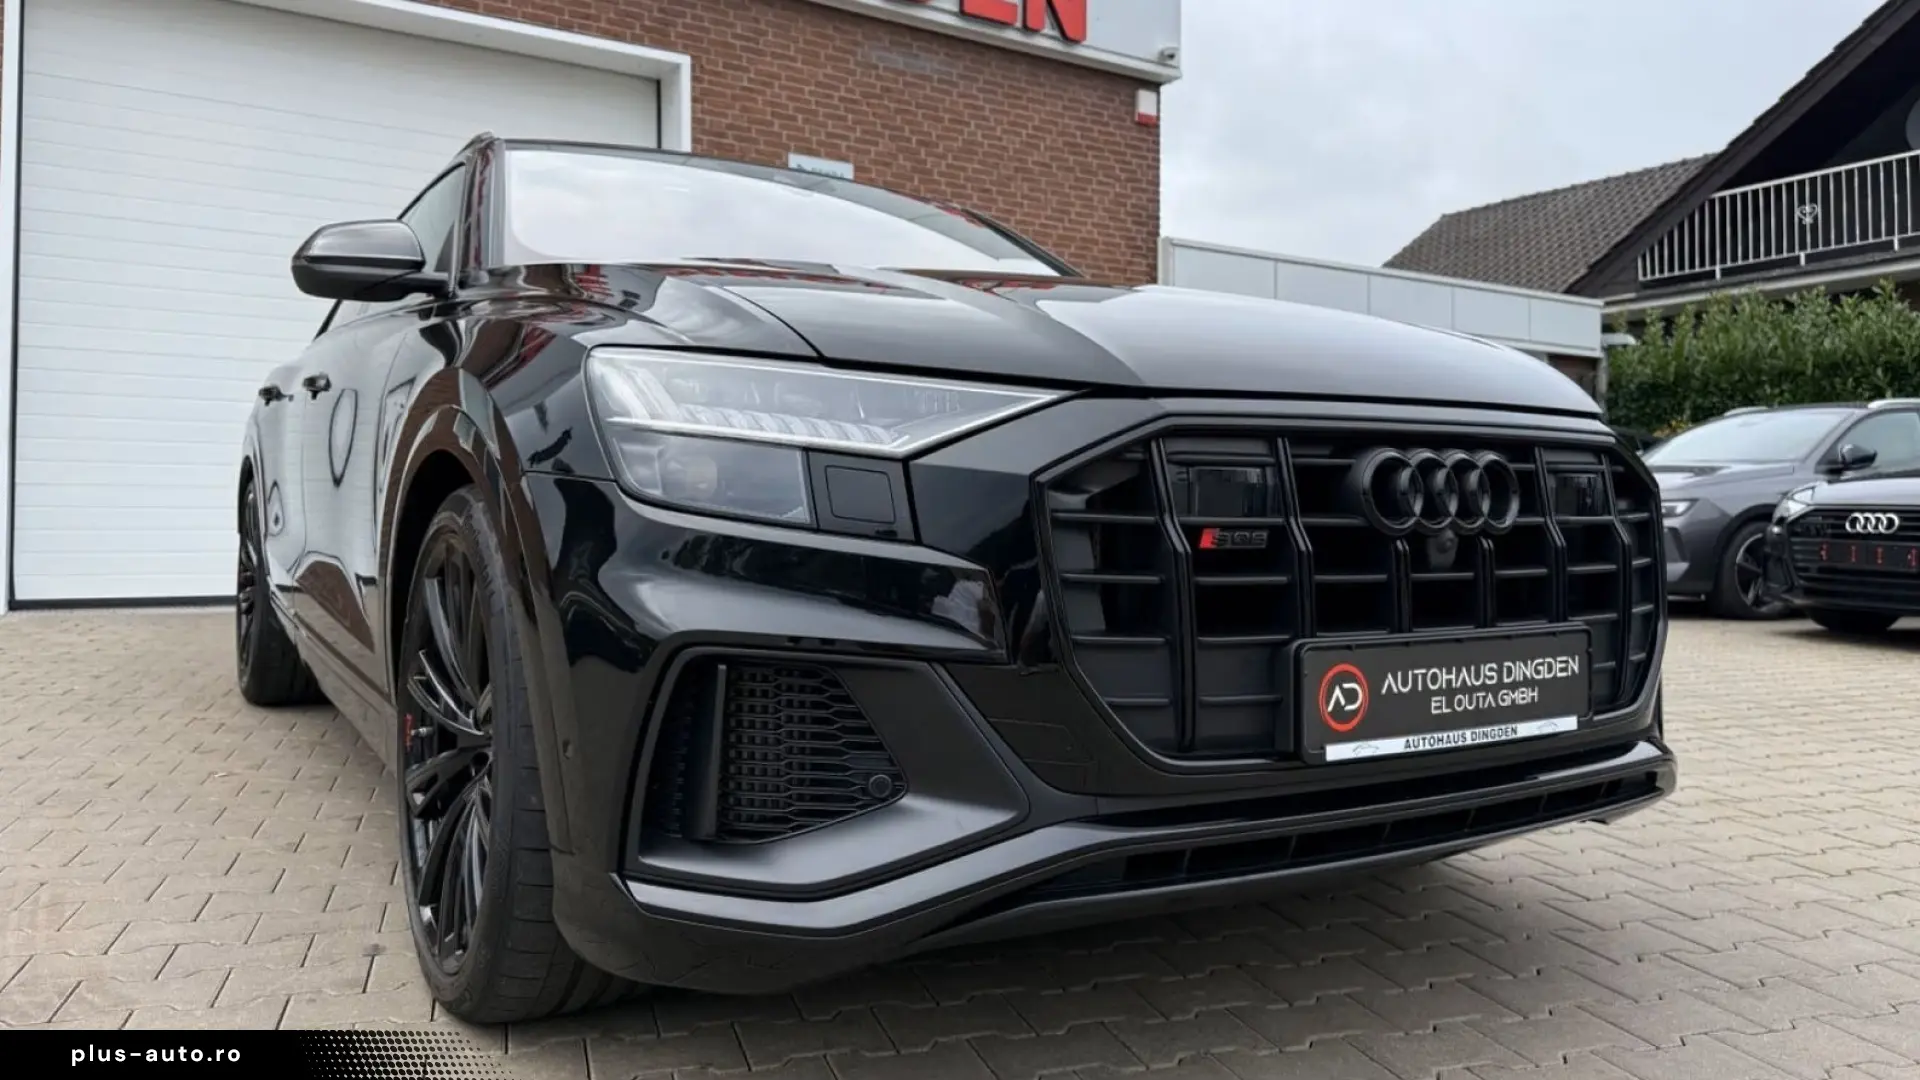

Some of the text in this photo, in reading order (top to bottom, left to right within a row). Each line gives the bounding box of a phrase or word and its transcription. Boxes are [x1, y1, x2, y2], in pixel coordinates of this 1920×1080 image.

[1381, 655, 1579, 695] AUTOHAUS DINGDEN
[1431, 686, 1539, 714] EL OUTA GMBH
[1404, 726, 1518, 749] AUTOHAUS DINGDEN
